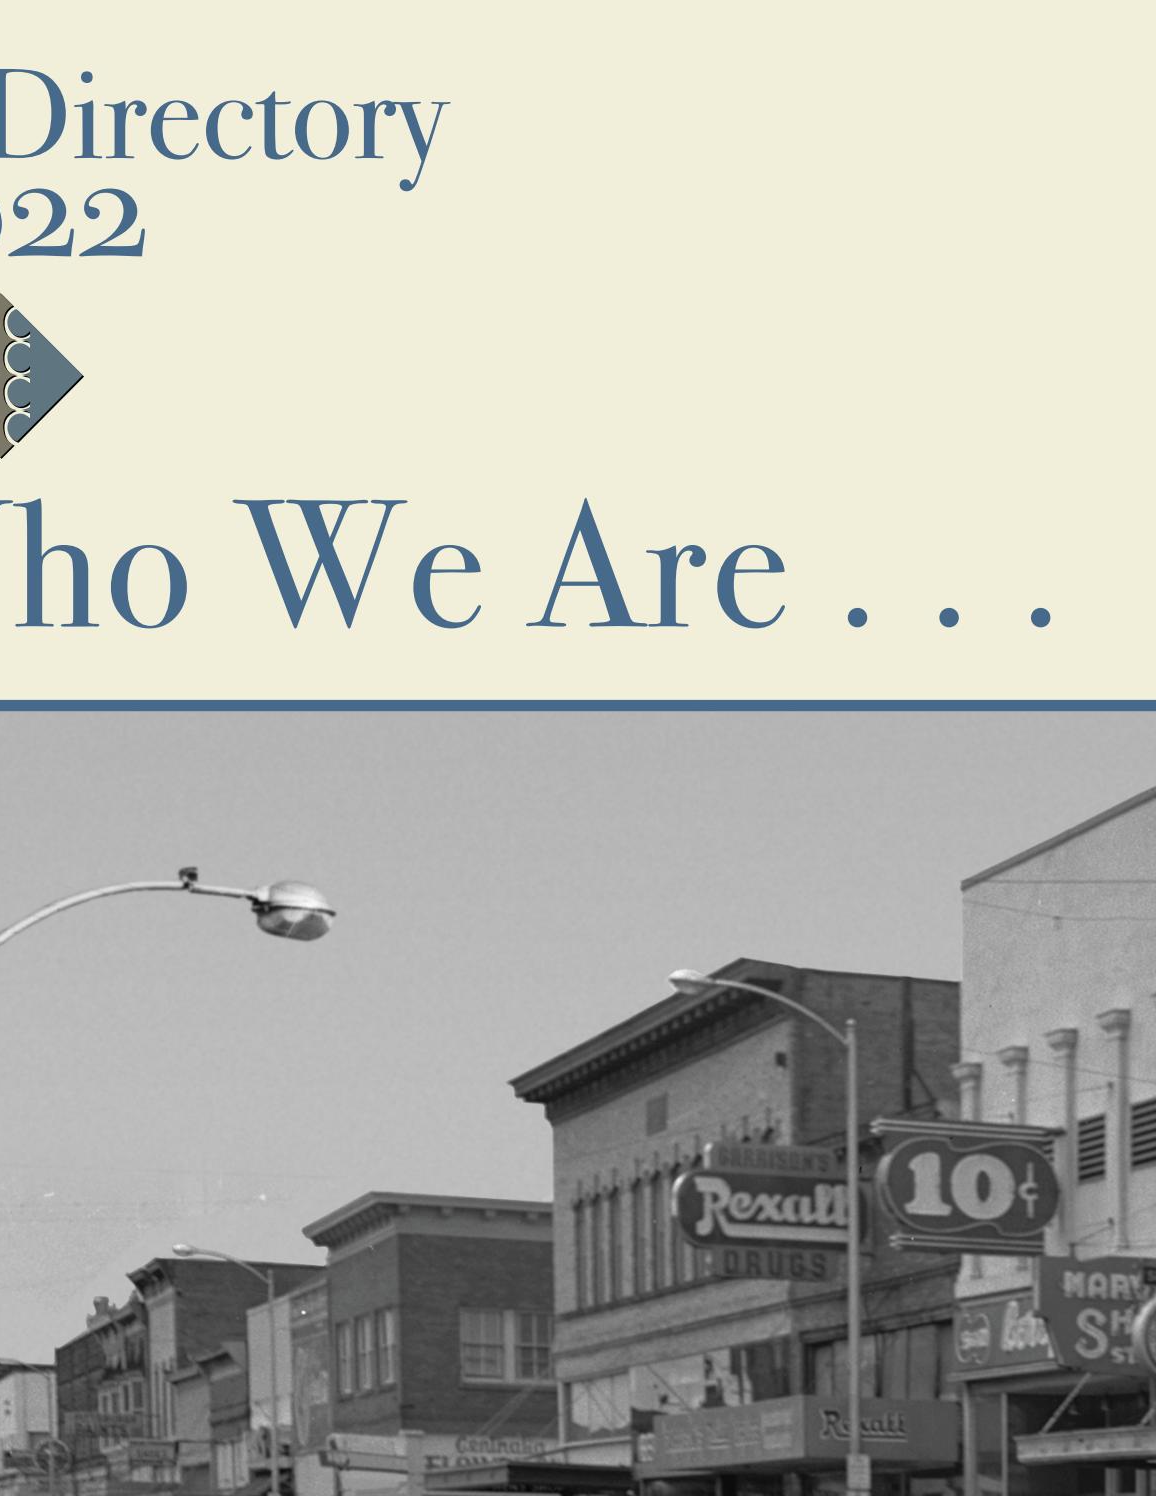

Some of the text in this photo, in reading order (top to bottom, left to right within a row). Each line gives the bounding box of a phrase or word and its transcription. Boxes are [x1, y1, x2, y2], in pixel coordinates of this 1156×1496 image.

[693, 1175, 849, 1239] Rexall
[903, 1151, 1040, 1221] 10¢
[723, 1251, 827, 1283] DRUGS
[820, 1408, 905, 1443] Rxall
